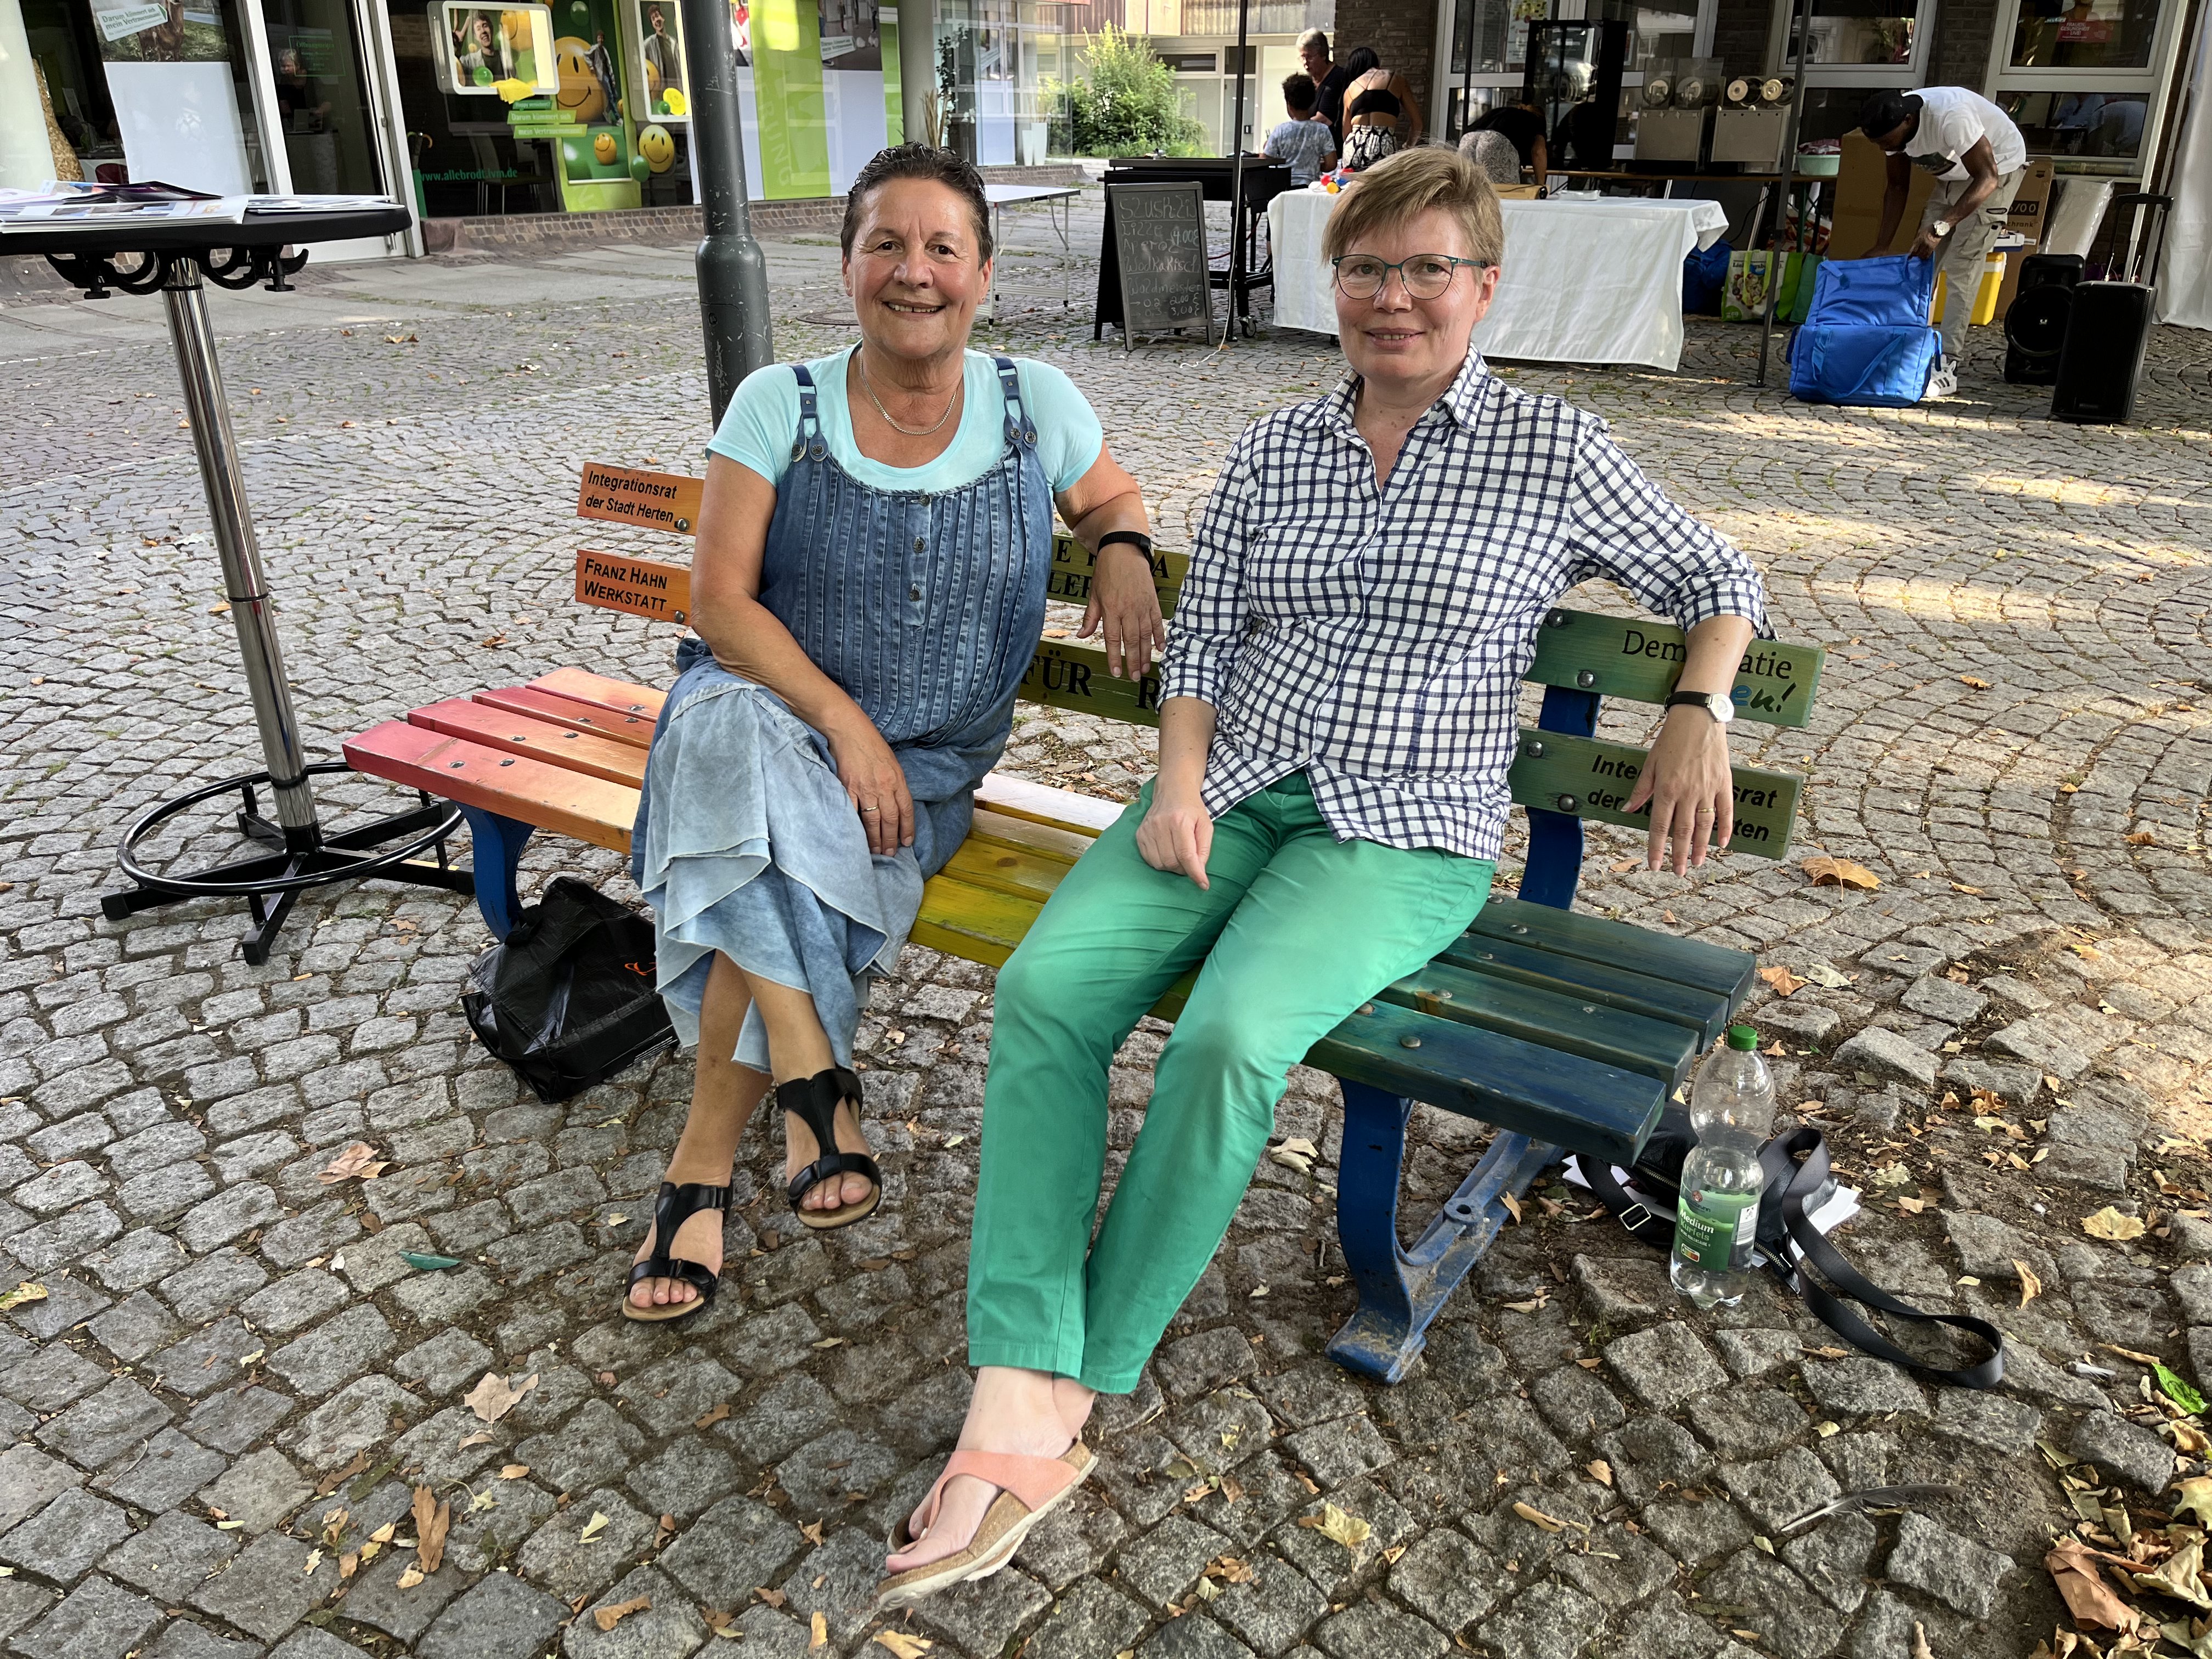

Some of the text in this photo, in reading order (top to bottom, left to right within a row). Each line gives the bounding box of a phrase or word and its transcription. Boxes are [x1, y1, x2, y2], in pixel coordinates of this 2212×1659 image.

[588, 471, 677, 499] Integrationsrat
[585, 495, 674, 523] der Stadt Herten
[584, 558, 667, 589] FRANZ HAHN
[584, 580, 667, 612] WERKSTATT
[1588, 789, 1625, 810] der
[1680, 1208, 1714, 1234] Medium
